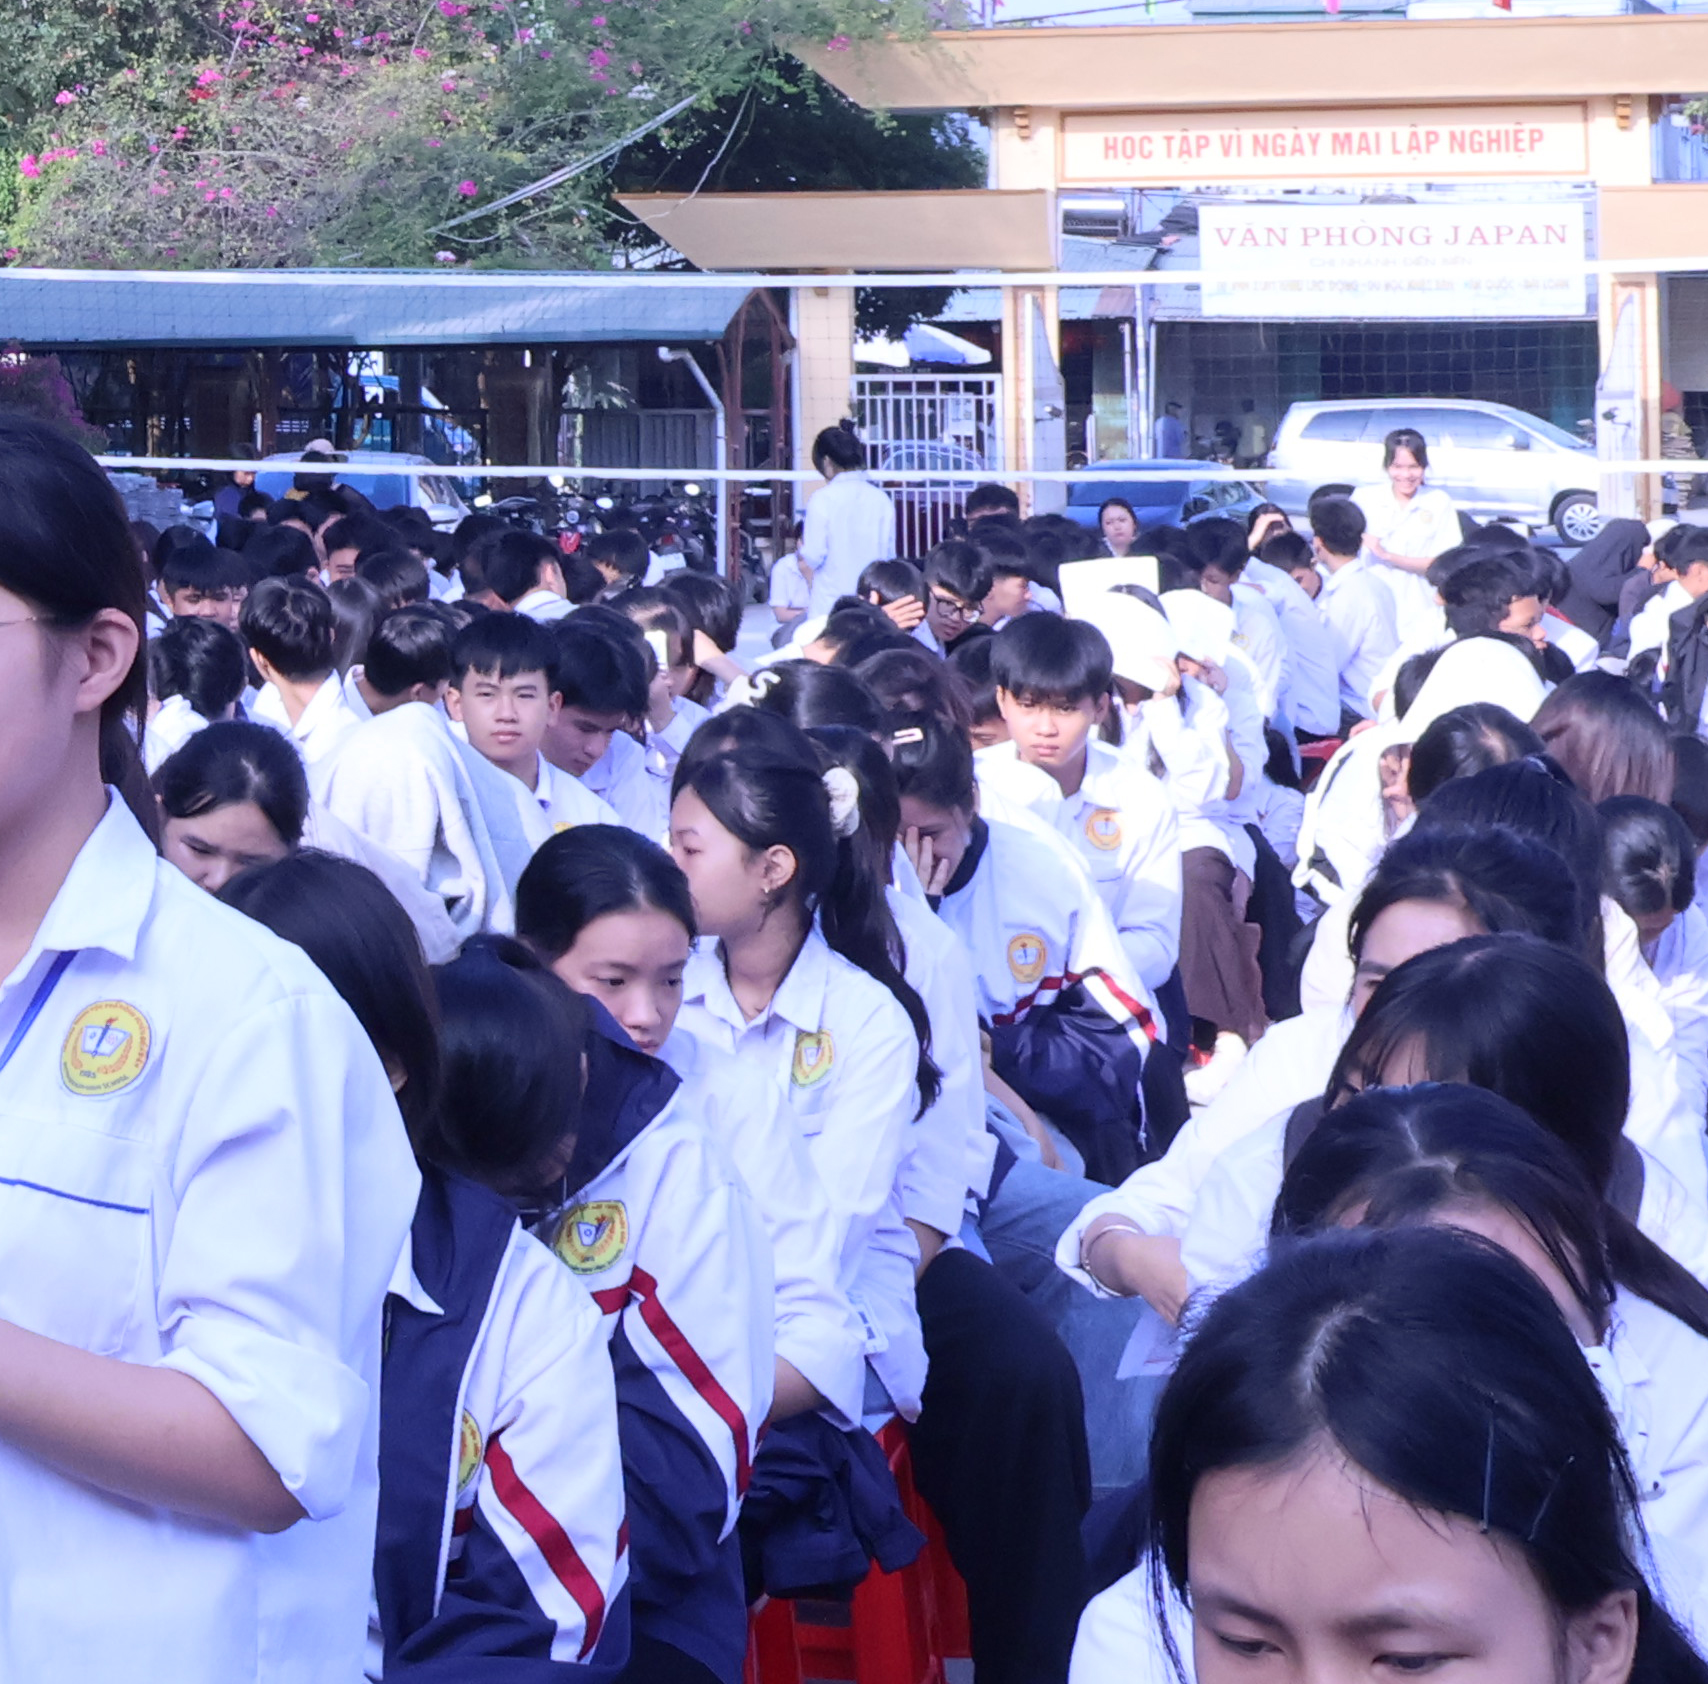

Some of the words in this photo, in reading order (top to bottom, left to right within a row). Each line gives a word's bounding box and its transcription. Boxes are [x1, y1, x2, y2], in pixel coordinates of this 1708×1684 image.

[1103, 135, 1153, 165] HỌC
[1163, 127, 1210, 164] TẬP
[1219, 127, 1242, 158] VÌ
[1252, 125, 1321, 157] NGÀY
[1332, 131, 1381, 155] MAI
[1392, 123, 1440, 160] LẬP
[1449, 121, 1544, 159] NGHIỆP
[1214, 221, 1289, 247] VĂN
[1300, 219, 1433, 247] PHÒNG
[1444, 224, 1569, 246] JAPAN
